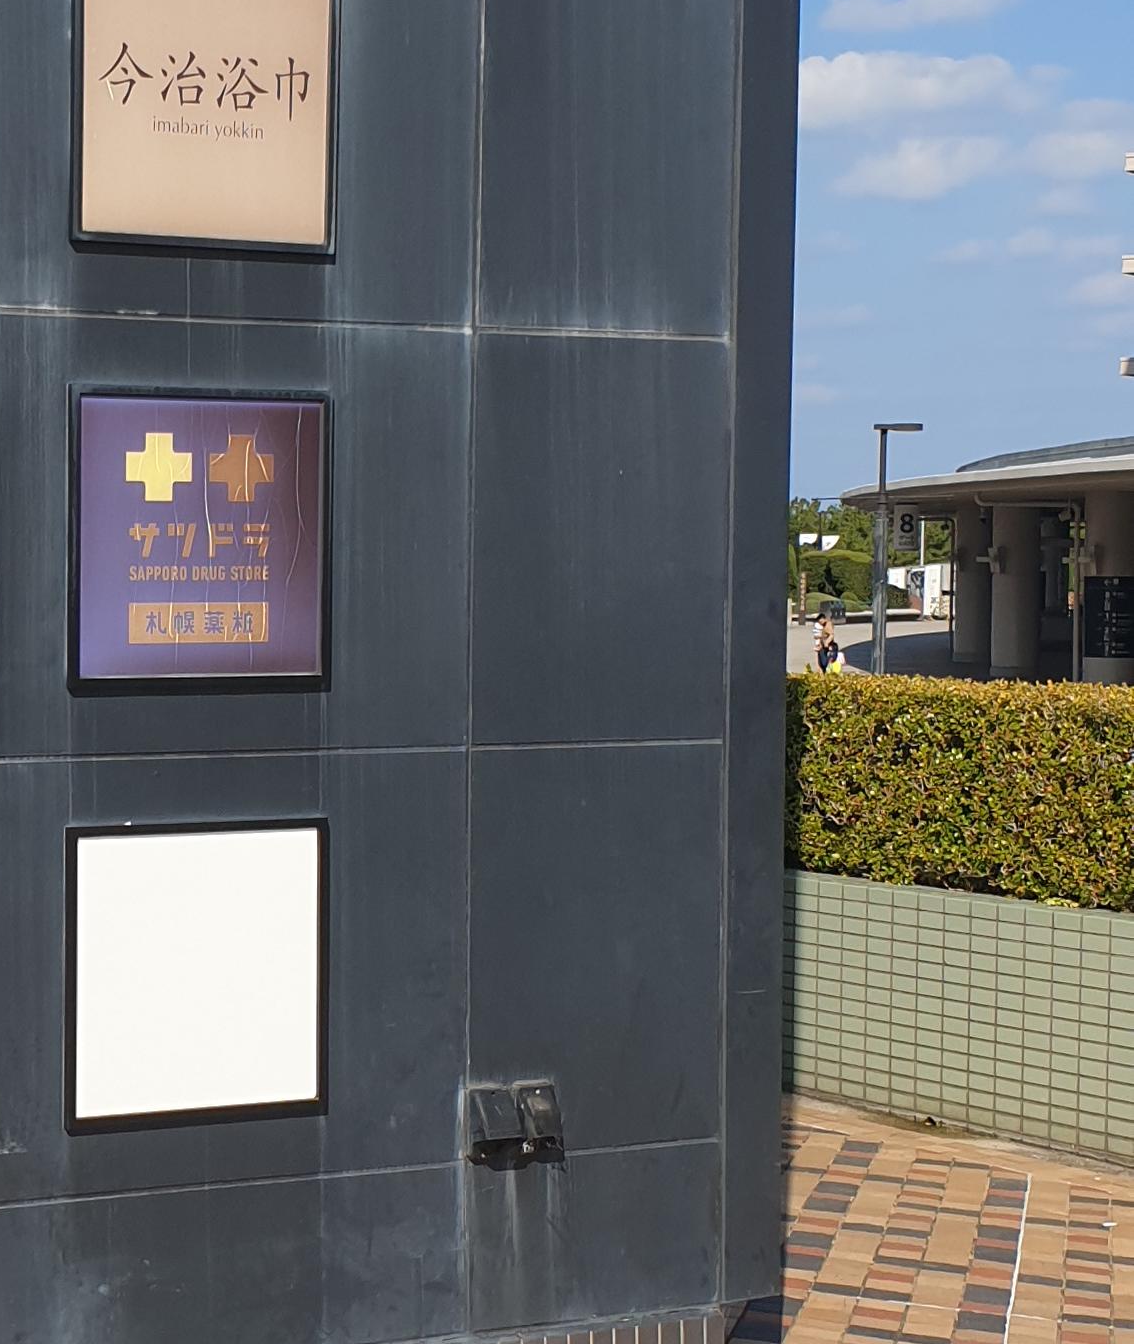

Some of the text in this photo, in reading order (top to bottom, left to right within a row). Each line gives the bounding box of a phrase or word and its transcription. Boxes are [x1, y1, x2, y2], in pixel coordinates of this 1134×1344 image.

[98, 42, 311, 122] 今治浴巾
[153, 115, 265, 141] imabari yokkin
[900, 513, 915, 533] 8
[129, 565, 270, 582] SAPPORO DRUG STORE
